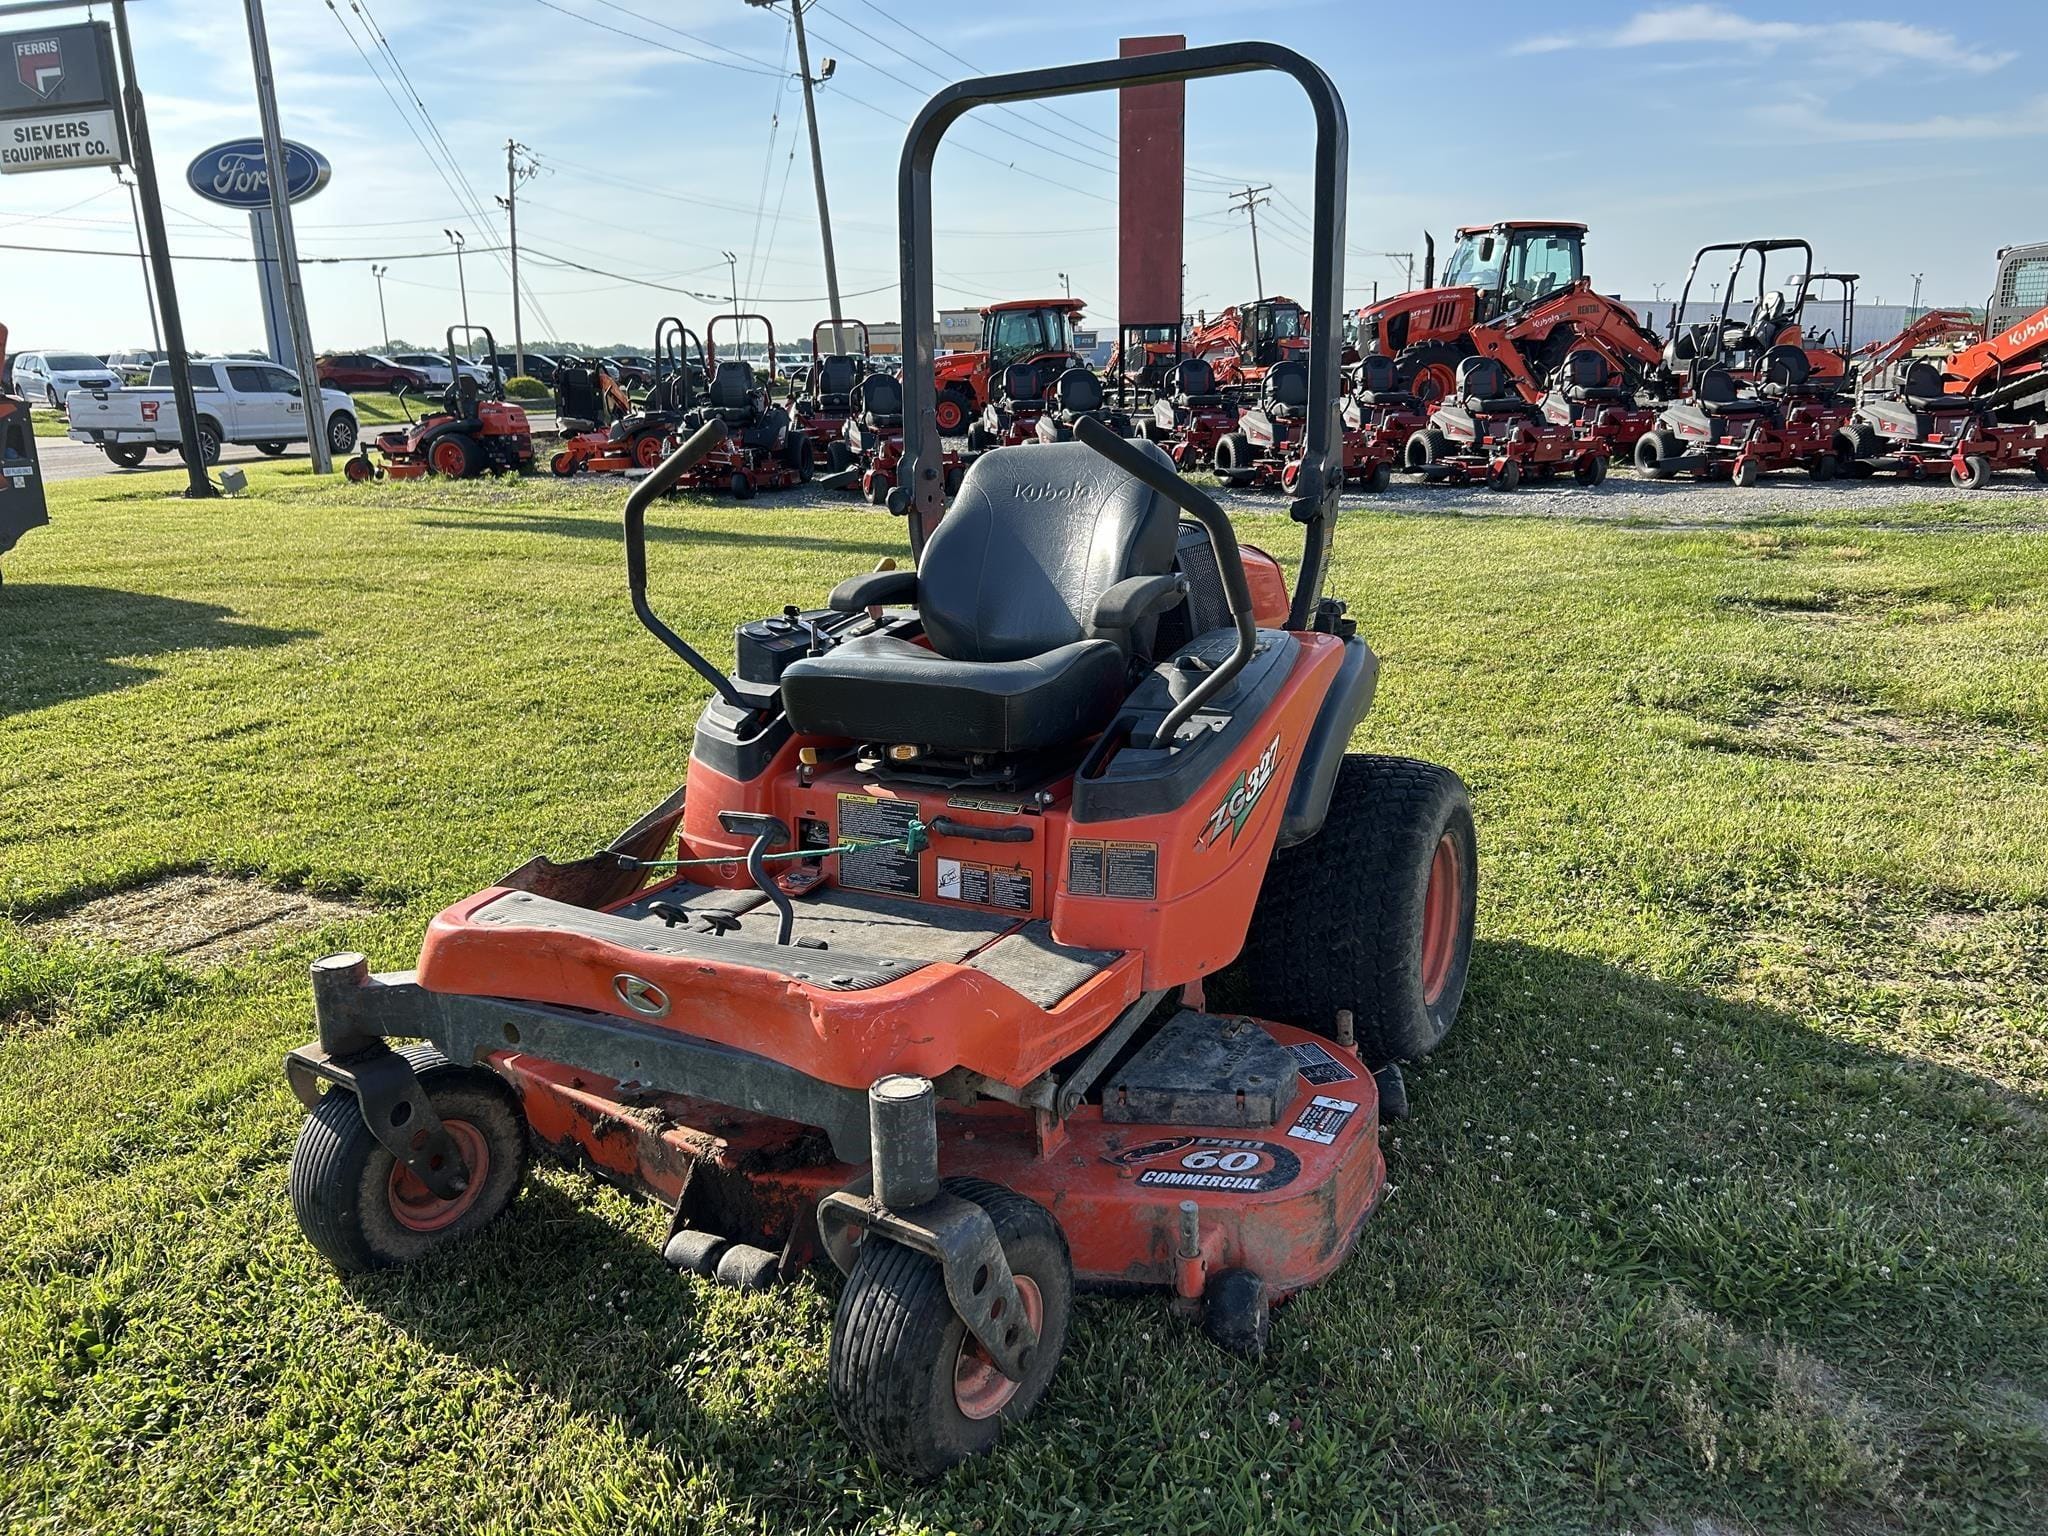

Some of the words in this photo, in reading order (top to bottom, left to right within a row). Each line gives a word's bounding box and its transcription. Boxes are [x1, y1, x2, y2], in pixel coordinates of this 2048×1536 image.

[17, 40, 58, 56] FERRIS
[13, 121, 90, 143] SIEVERS
[1, 142, 81, 163] EQUIPMENT
[85, 140, 110, 155] CO.
[1577, 304, 1600, 315] RENTAL
[1532, 314, 1560, 328] Kubota
[1014, 480, 1094, 504] Kubota
[1208, 733, 1280, 847] ZG327
[1181, 1150, 1260, 1171] 60
[1141, 1171, 1261, 1190] COMMERCIAL
